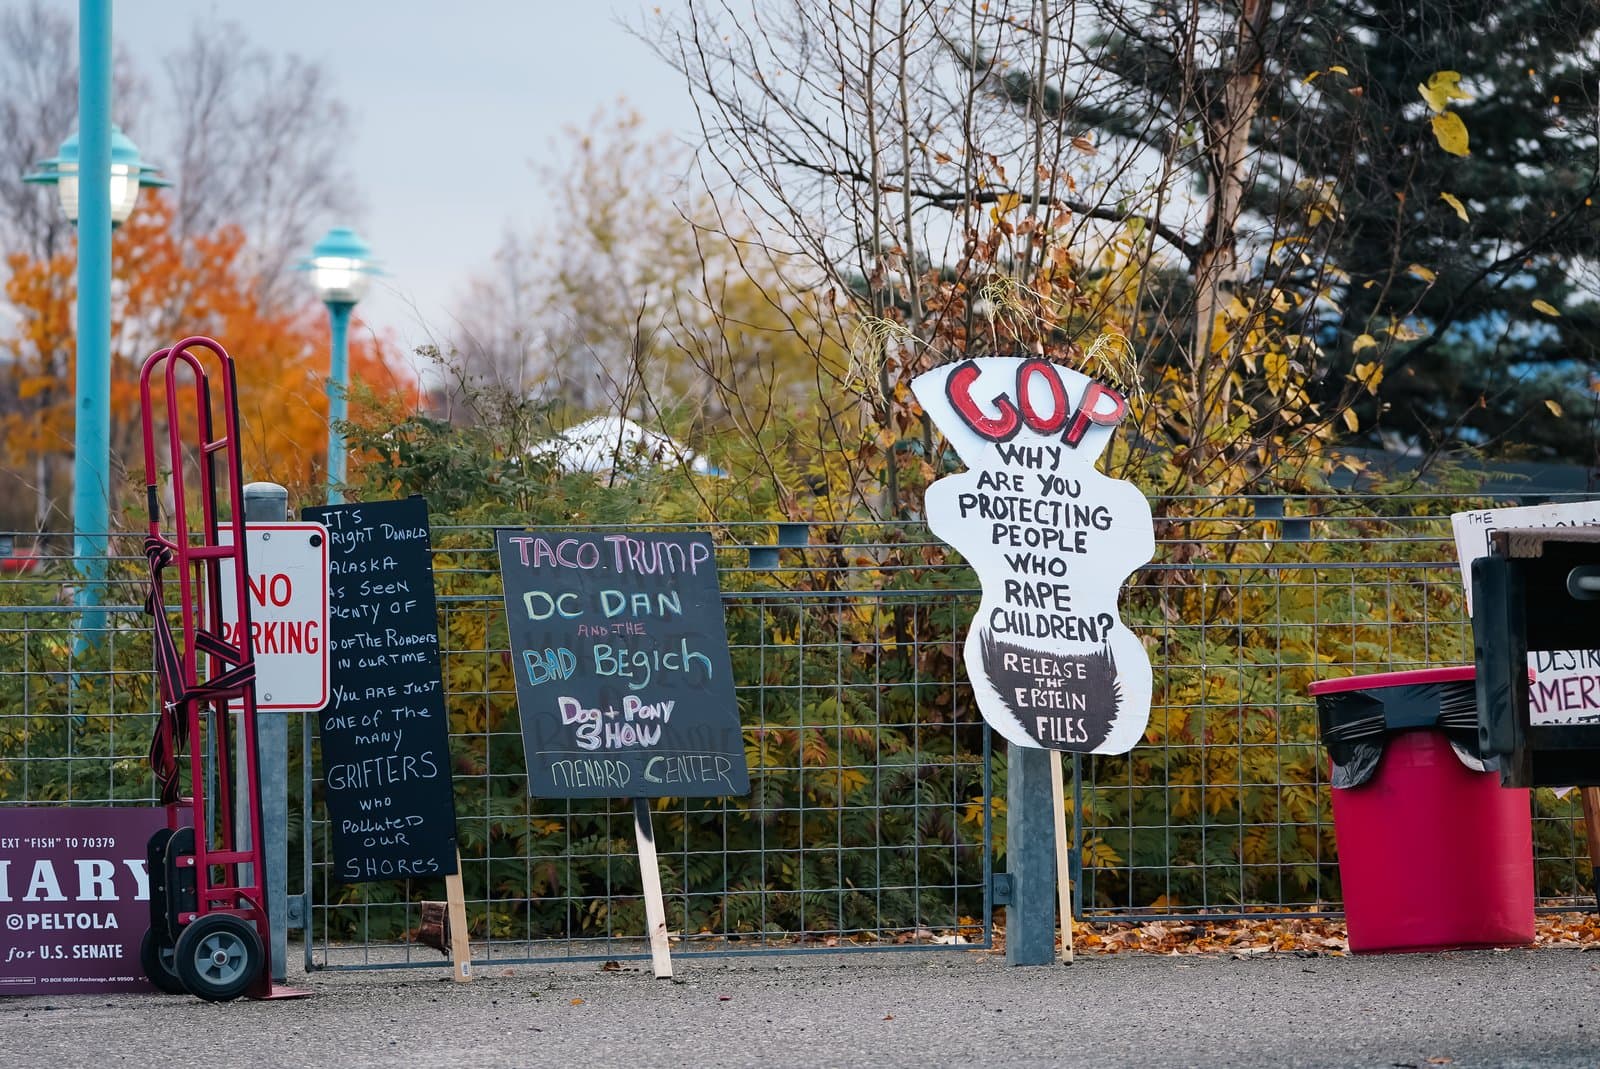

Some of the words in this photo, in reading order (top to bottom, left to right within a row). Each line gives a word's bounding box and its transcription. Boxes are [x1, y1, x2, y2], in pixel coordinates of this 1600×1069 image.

[945, 359, 1129, 449] GOP
[995, 443, 1062, 471] WHY
[976, 470, 1024, 492] ARE
[1037, 474, 1081, 498] YOU
[322, 509, 362, 530] IT'S
[958, 493, 1113, 530] PROTECTING
[1468, 512, 1493, 525] THE
[992, 523, 1087, 553] PEOPLE
[509, 536, 600, 569] TACO
[604, 535, 709, 576] TRUMP
[1003, 552, 1067, 577] WHO
[248, 573, 292, 607] NO
[1004, 579, 1071, 612] RAPE
[390, 600, 417, 614] OF
[523, 590, 584, 620] DC
[600, 589, 682, 619] DAN
[223, 620, 319, 655] PARKING
[577, 623, 609, 637] AND
[611, 623, 647, 635] THE
[990, 607, 1114, 643] CHILDREN?
[341, 638, 356, 649] OF
[522, 648, 577, 686] BAD
[1003, 652, 1088, 680] RELEASE
[1536, 650, 1600, 673] DESTR
[365, 686, 398, 700] ARE
[1034, 677, 1067, 688] THE
[1014, 687, 1087, 711] EPSTEIN
[325, 715, 357, 730] ONE
[1036, 716, 1089, 743] FILES
[576, 723, 661, 751] SHOW
[327, 751, 438, 790] GRIFTERS
[551, 758, 631, 789] MENARD
[643, 755, 737, 793] CENTER
[0, 838, 20, 848] EXT
[65, 838, 78, 848] TO
[82, 837, 115, 848] 70379
[0, 859, 150, 902] ARY
[27, 912, 119, 930] PELTOLA
[5, 947, 36, 962] for
[40, 945, 69, 959] U.S.
[72, 944, 123, 958] SENATE
